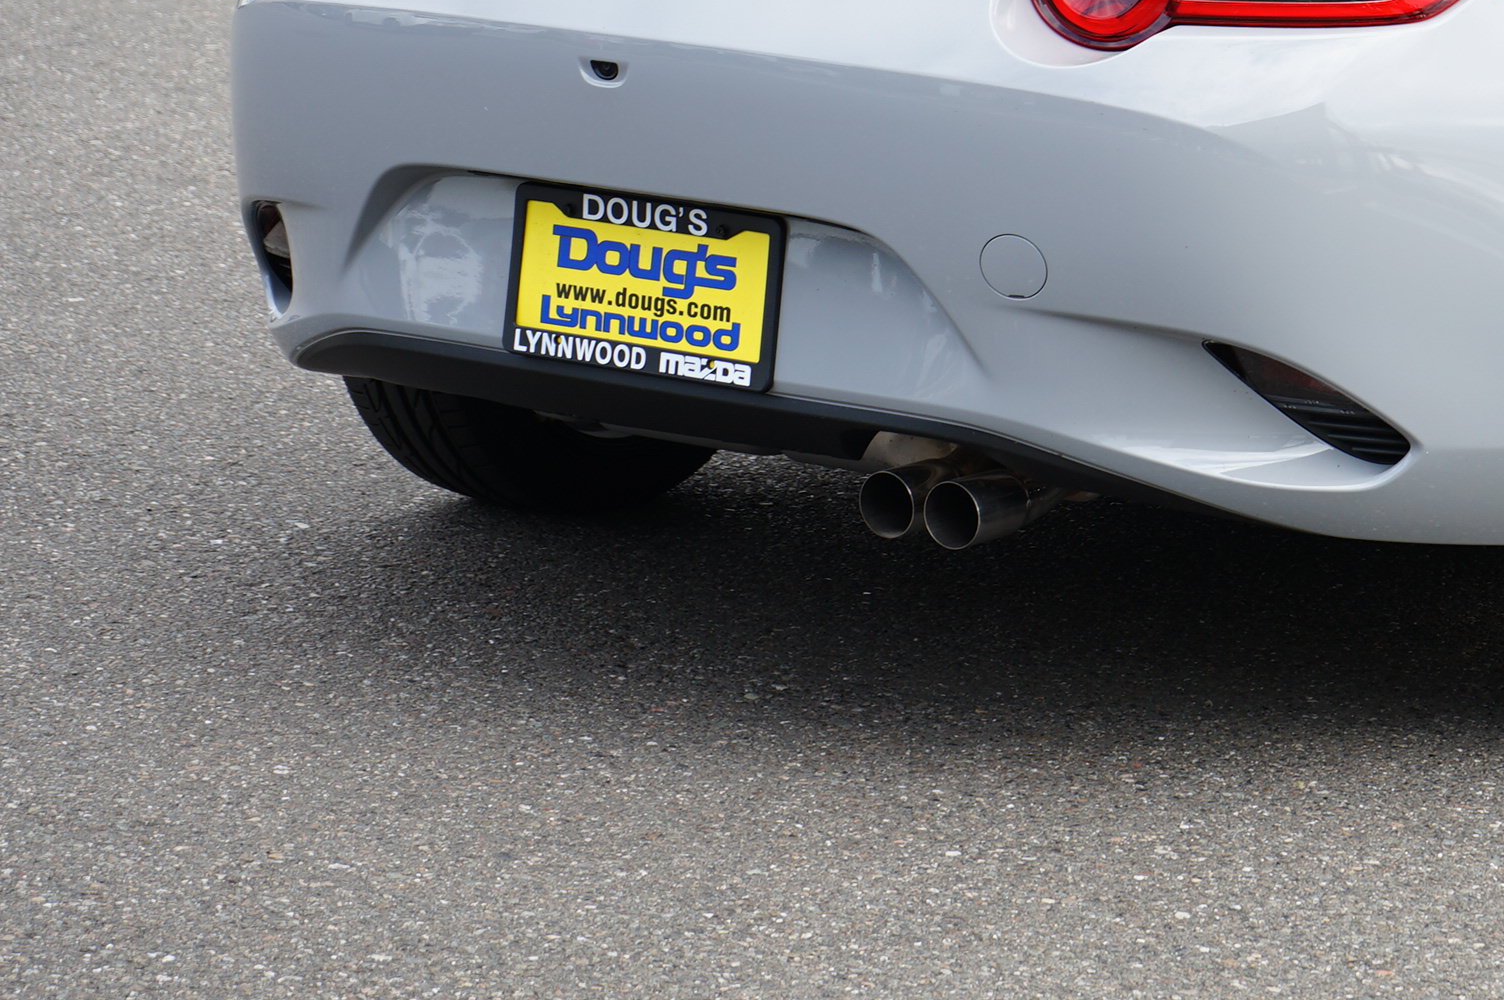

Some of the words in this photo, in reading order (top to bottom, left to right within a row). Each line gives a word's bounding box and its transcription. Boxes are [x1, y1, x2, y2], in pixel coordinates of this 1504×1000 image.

[582, 193, 709, 237] DOUG'S
[553, 224, 738, 299] Doug's
[540, 294, 741, 351] Lynnwood
[556, 283, 732, 323] www.dougs.com
[513, 328, 647, 370] LYNNWOOD
